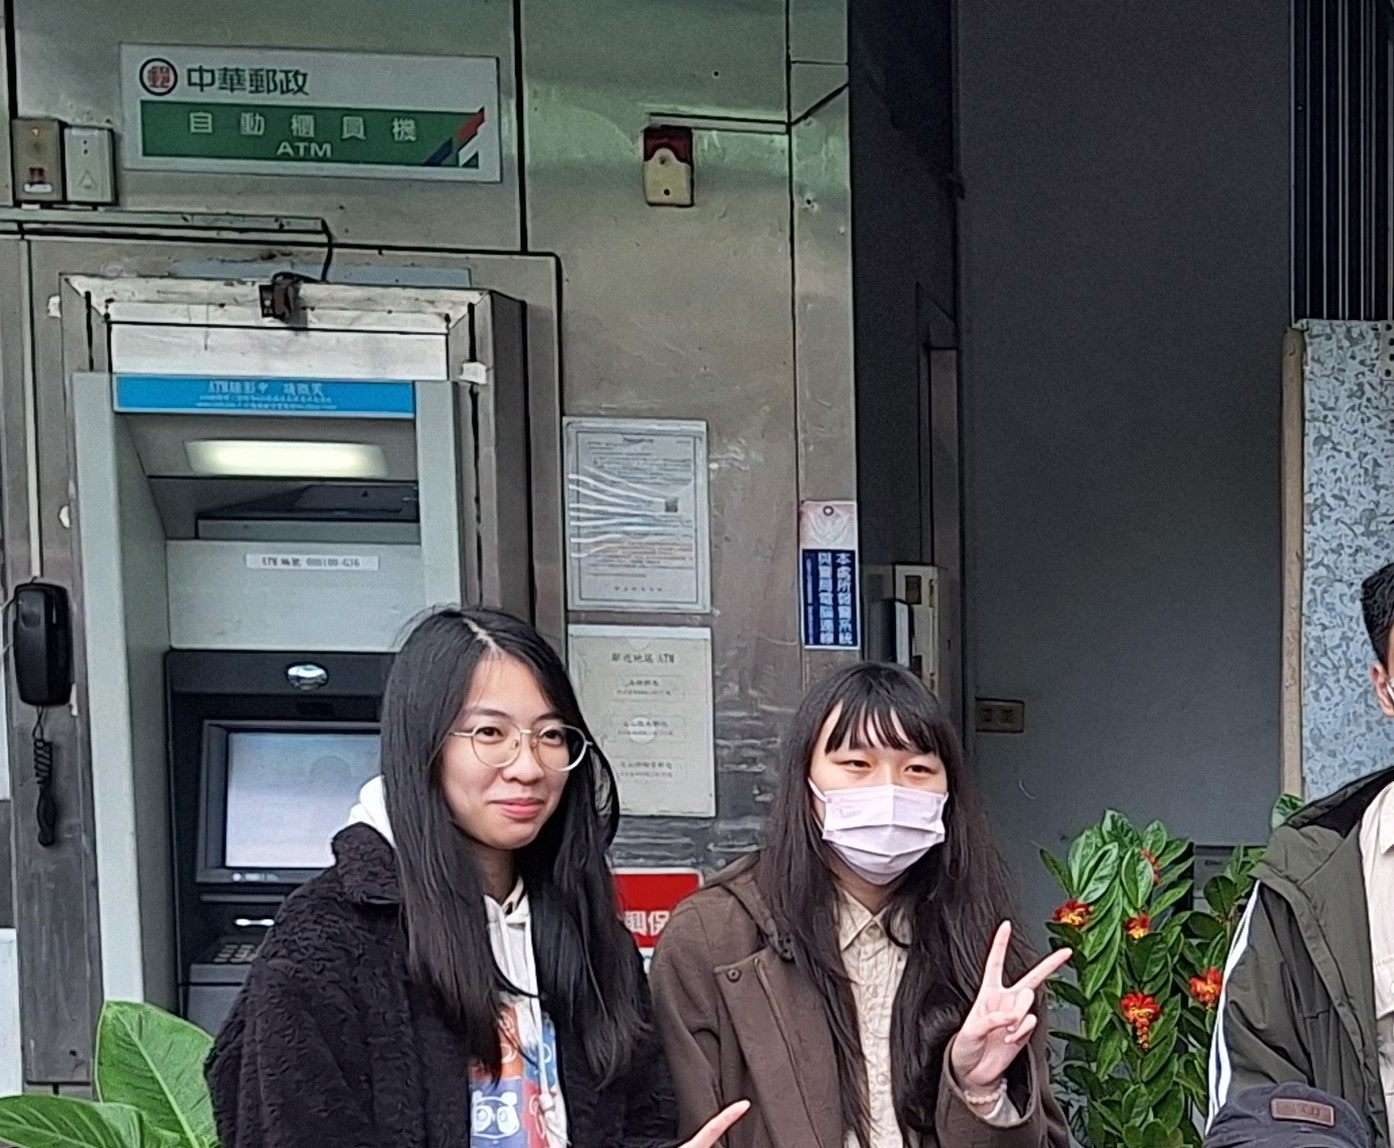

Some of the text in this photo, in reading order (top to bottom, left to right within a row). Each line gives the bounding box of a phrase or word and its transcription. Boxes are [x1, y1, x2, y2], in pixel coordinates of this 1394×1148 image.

[186, 65, 310, 96] 中華郵政
[188, 111, 419, 142] 自動櫃員機
[276, 142, 333, 159] ATM
